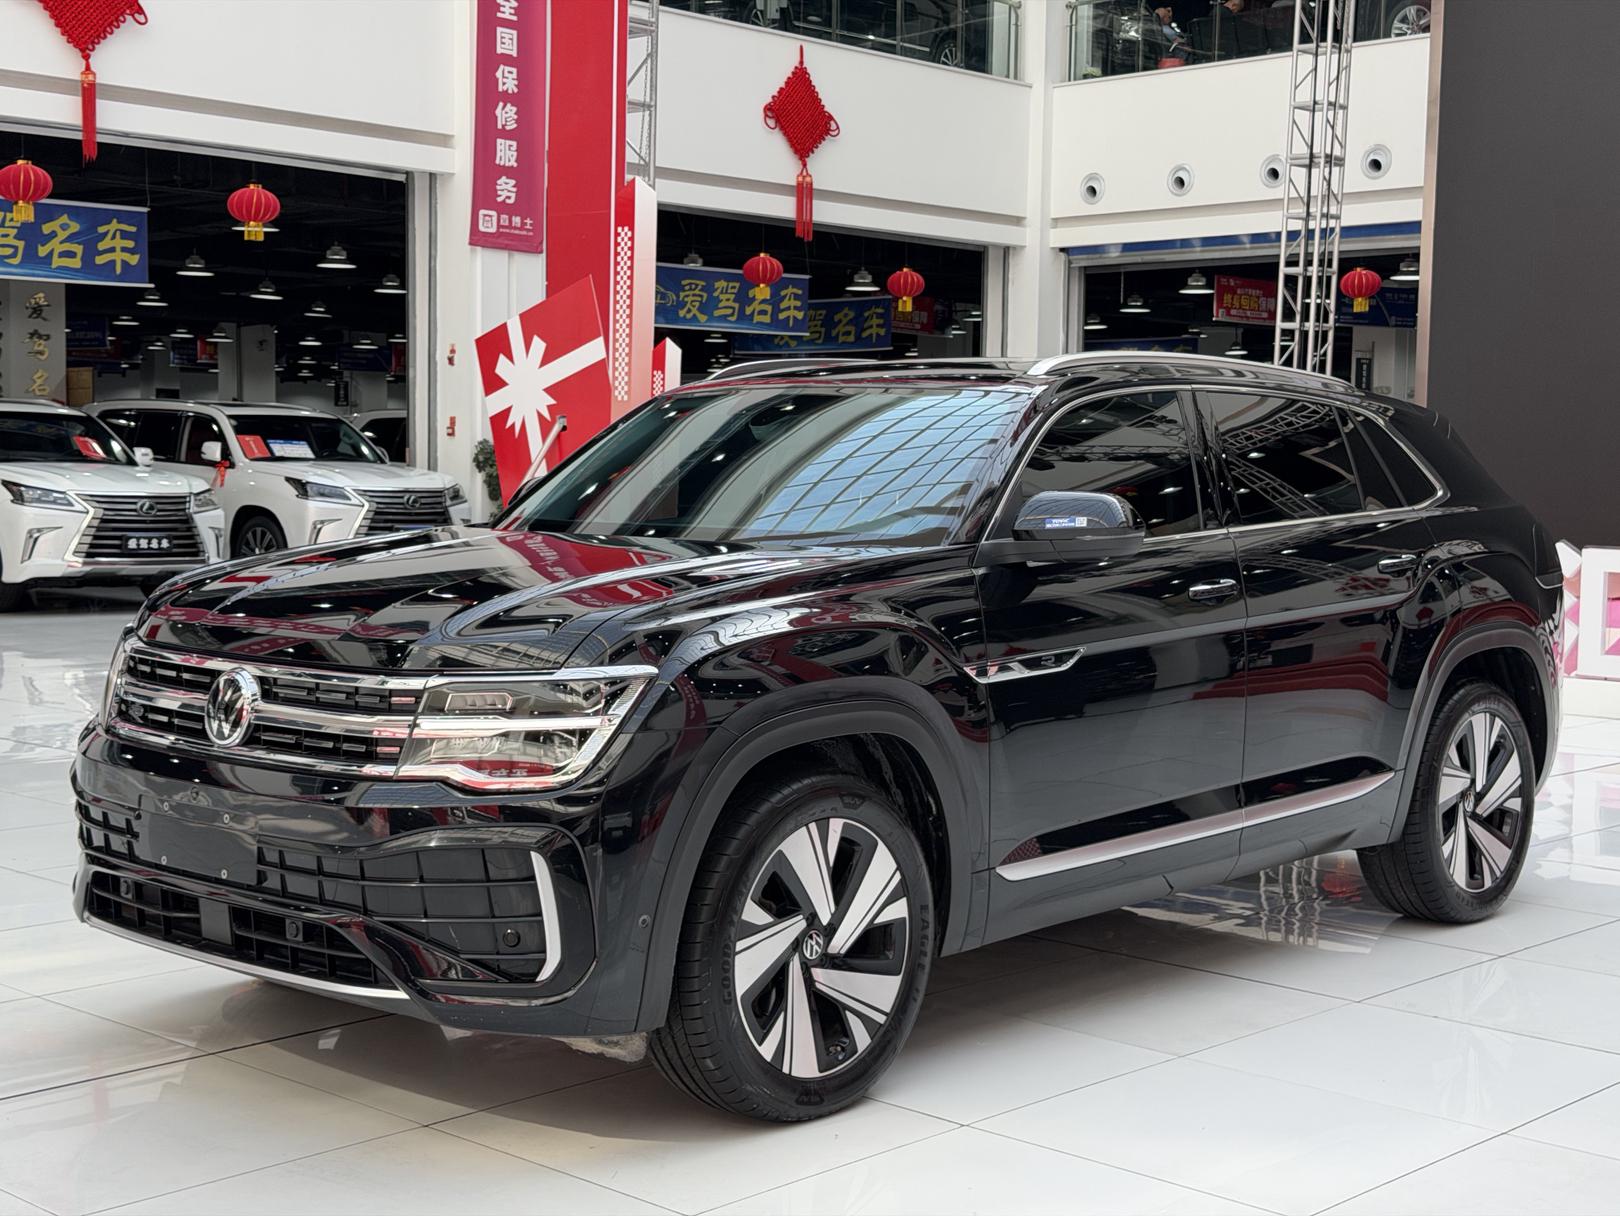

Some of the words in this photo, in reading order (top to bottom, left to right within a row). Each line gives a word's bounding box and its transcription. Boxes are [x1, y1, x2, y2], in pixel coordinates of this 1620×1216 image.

[495, 0, 519, 204] 全国保修服务
[678, 279, 805, 328] 爱驾名车
